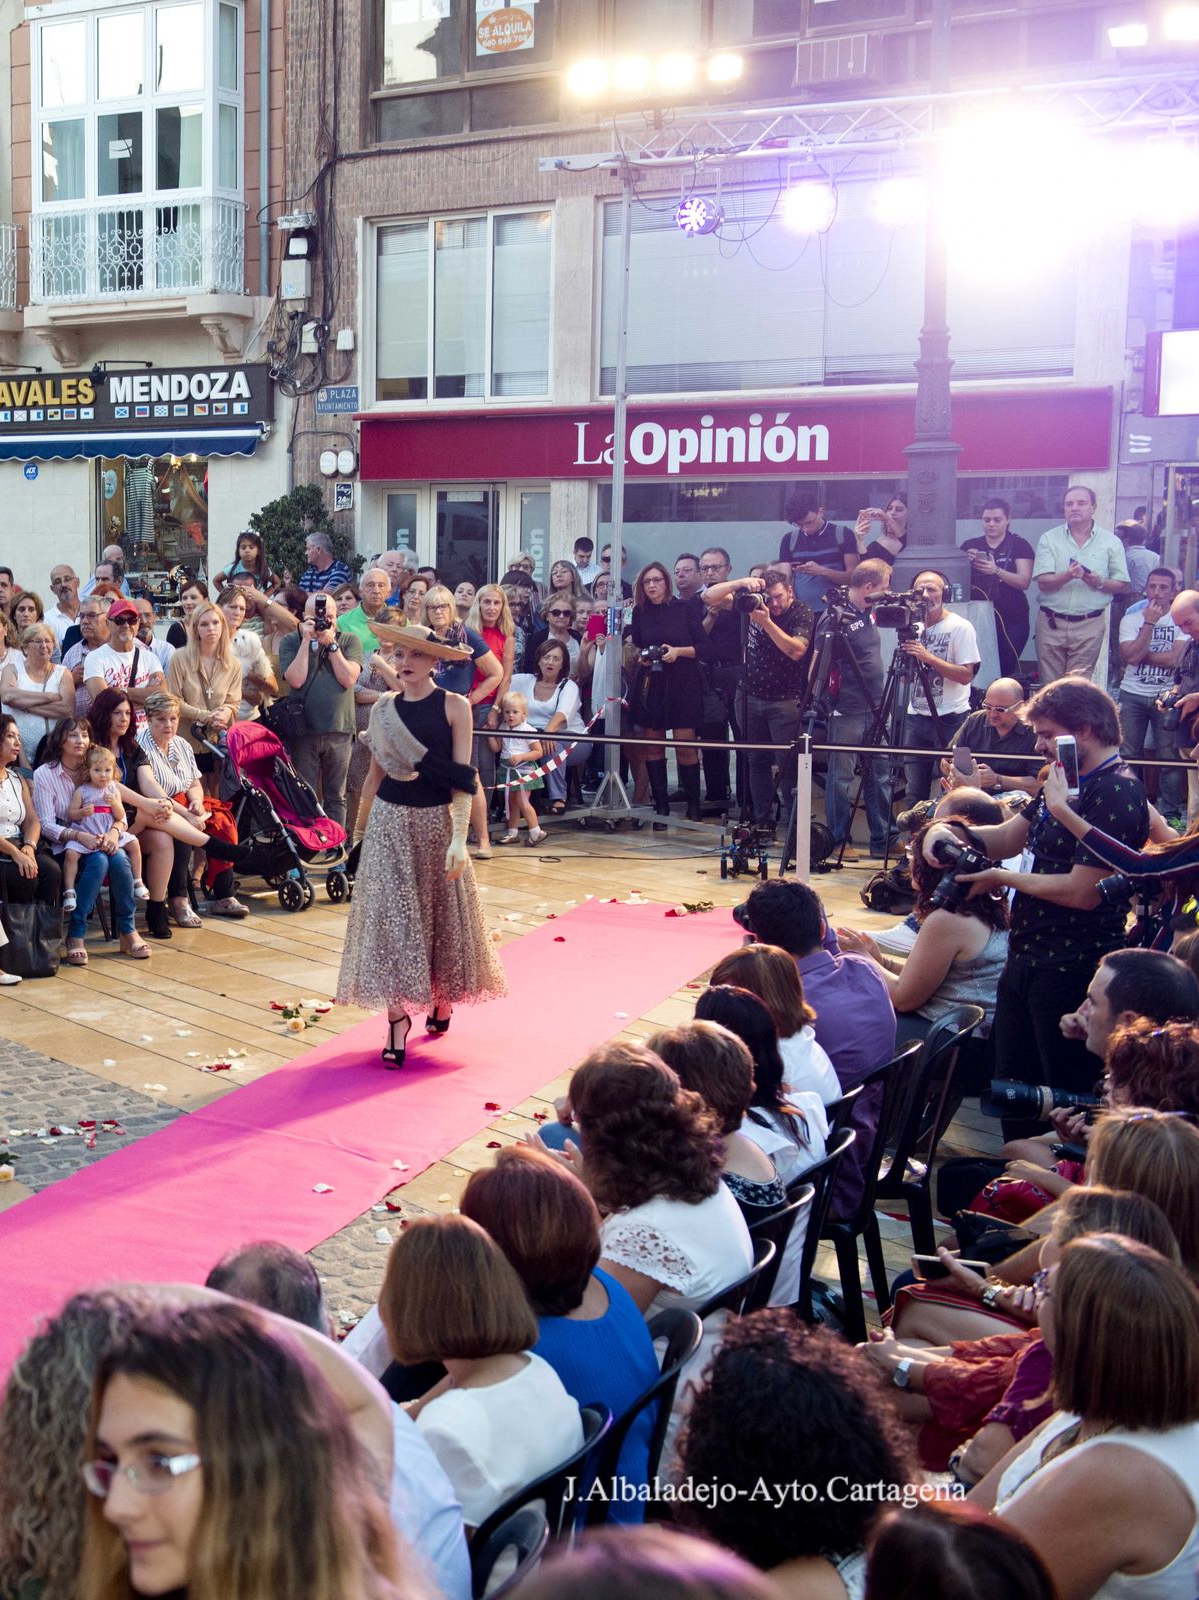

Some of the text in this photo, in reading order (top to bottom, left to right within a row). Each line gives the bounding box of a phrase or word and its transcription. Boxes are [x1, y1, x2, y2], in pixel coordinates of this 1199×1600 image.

[478, 20, 532, 39] SE ALQUILA
[109, 371, 252, 403] MENDOZA
[330, 389, 357, 399] PLAZA
[317, 402, 358, 411] AYUNTAMIENTO
